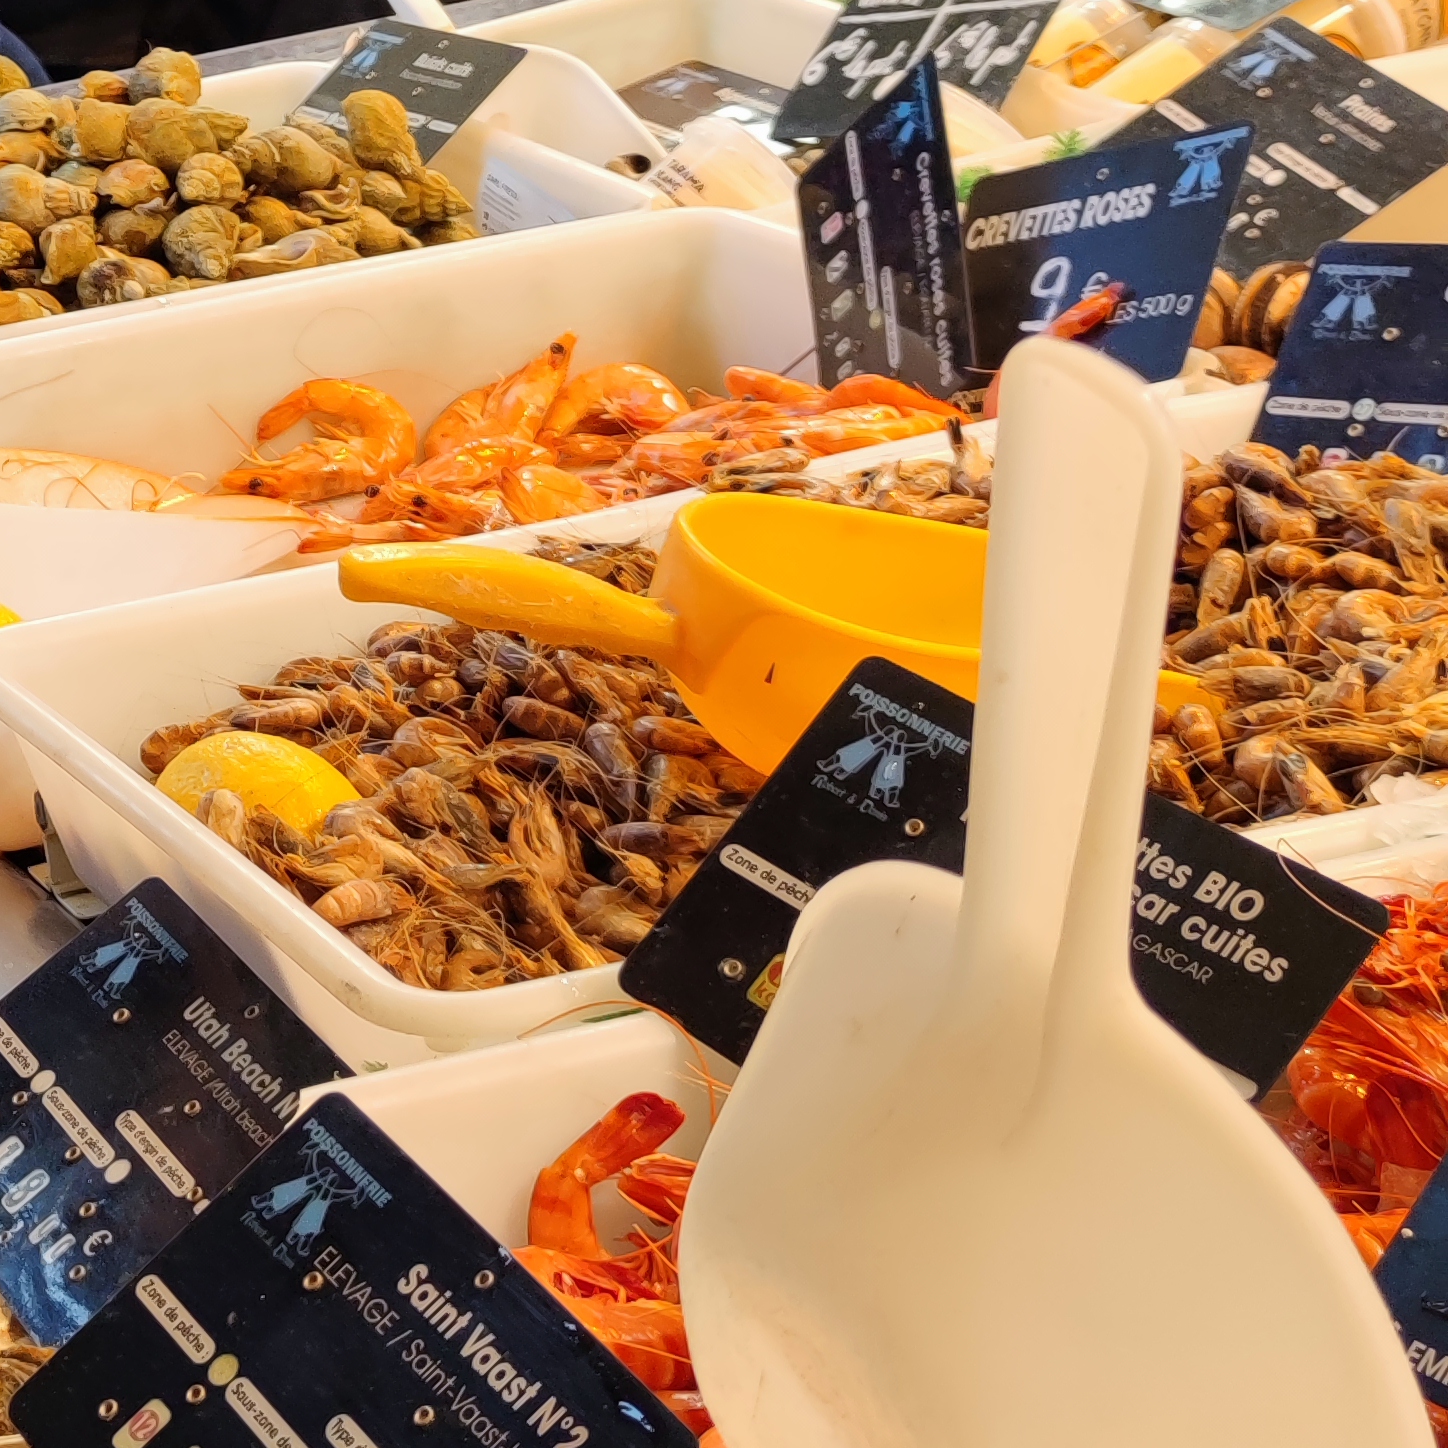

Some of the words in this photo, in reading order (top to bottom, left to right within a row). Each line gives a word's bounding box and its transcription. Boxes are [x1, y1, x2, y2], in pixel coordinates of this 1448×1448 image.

[965, 197, 1082, 251] CREVETTES
[1077, 182, 1157, 231] ROSES
[848, 682, 972, 756] POISSONNERIE
[723, 847, 761, 875] Zone
[758, 867, 778, 886] de
[774, 877, 814, 906] pêch
[1137, 837, 1193, 890] ttes
[1193, 870, 1265, 922] BIO
[1132, 933, 1213, 985] GASCAR
[1180, 915, 1290, 983] cuites
[0, 1033, 15, 1049] de
[7, 1043, 34, 1072] pêche
[160, 1027, 214, 1084] ELEVAGE
[180, 993, 236, 1050] Utah
[219, 1035, 287, 1106] Beach
[269, 1088, 305, 1122] N
[82, 1133, 110, 1162] pêche
[118, 1112, 139, 1134] Type
[161, 1162, 189, 1190] pêche
[303, 1117, 393, 1208] POISSONNERIE
[79, 1225, 114, 1259] €
[139, 1278, 169, 1310] Zone
[160, 1303, 181, 1324] de
[171, 1316, 209, 1356] pêche
[311, 1242, 400, 1338] ELEVAGE
[392, 1260, 472, 1344] Saint
[453, 1320, 543, 1415] Vaast
[1405, 1338, 1448, 1386] EM
[129, 1411, 158, 1440] 12
[227, 1381, 283, 1442] Sous-zone
